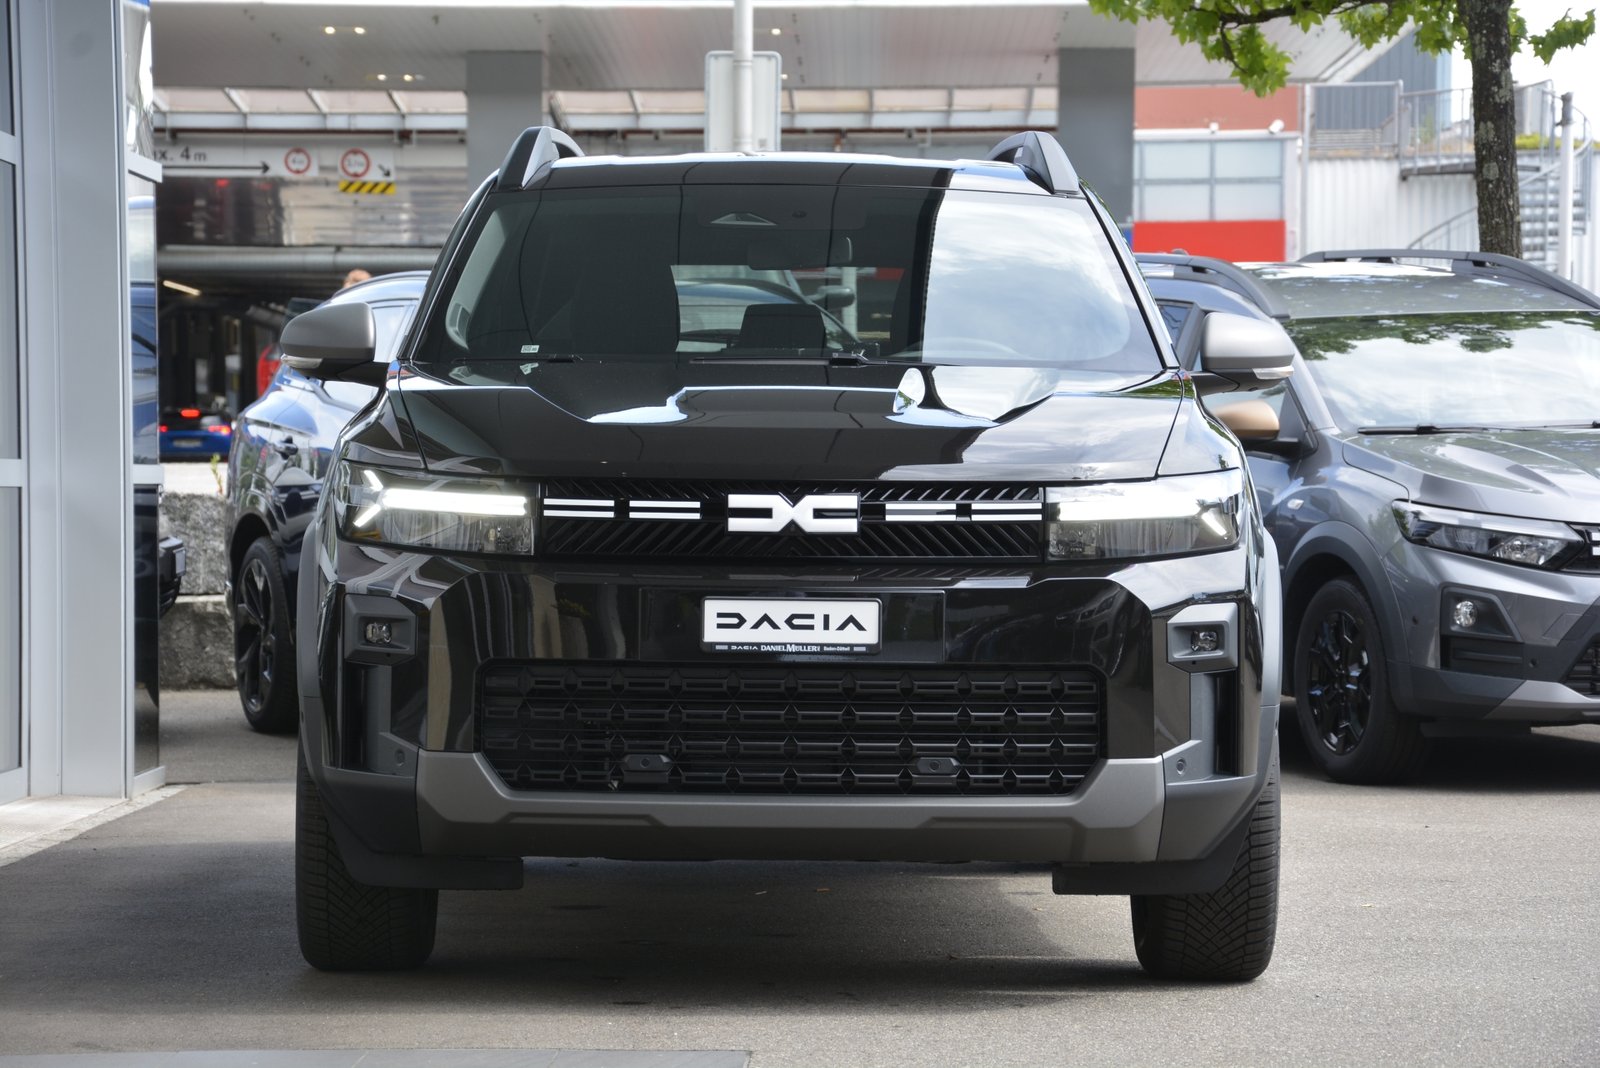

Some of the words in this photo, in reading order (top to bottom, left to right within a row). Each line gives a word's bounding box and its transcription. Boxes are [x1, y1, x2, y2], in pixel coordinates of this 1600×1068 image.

[180, 146, 190, 160] 4
[193, 151, 207, 161] m
[716, 612, 867, 632] DACIA
